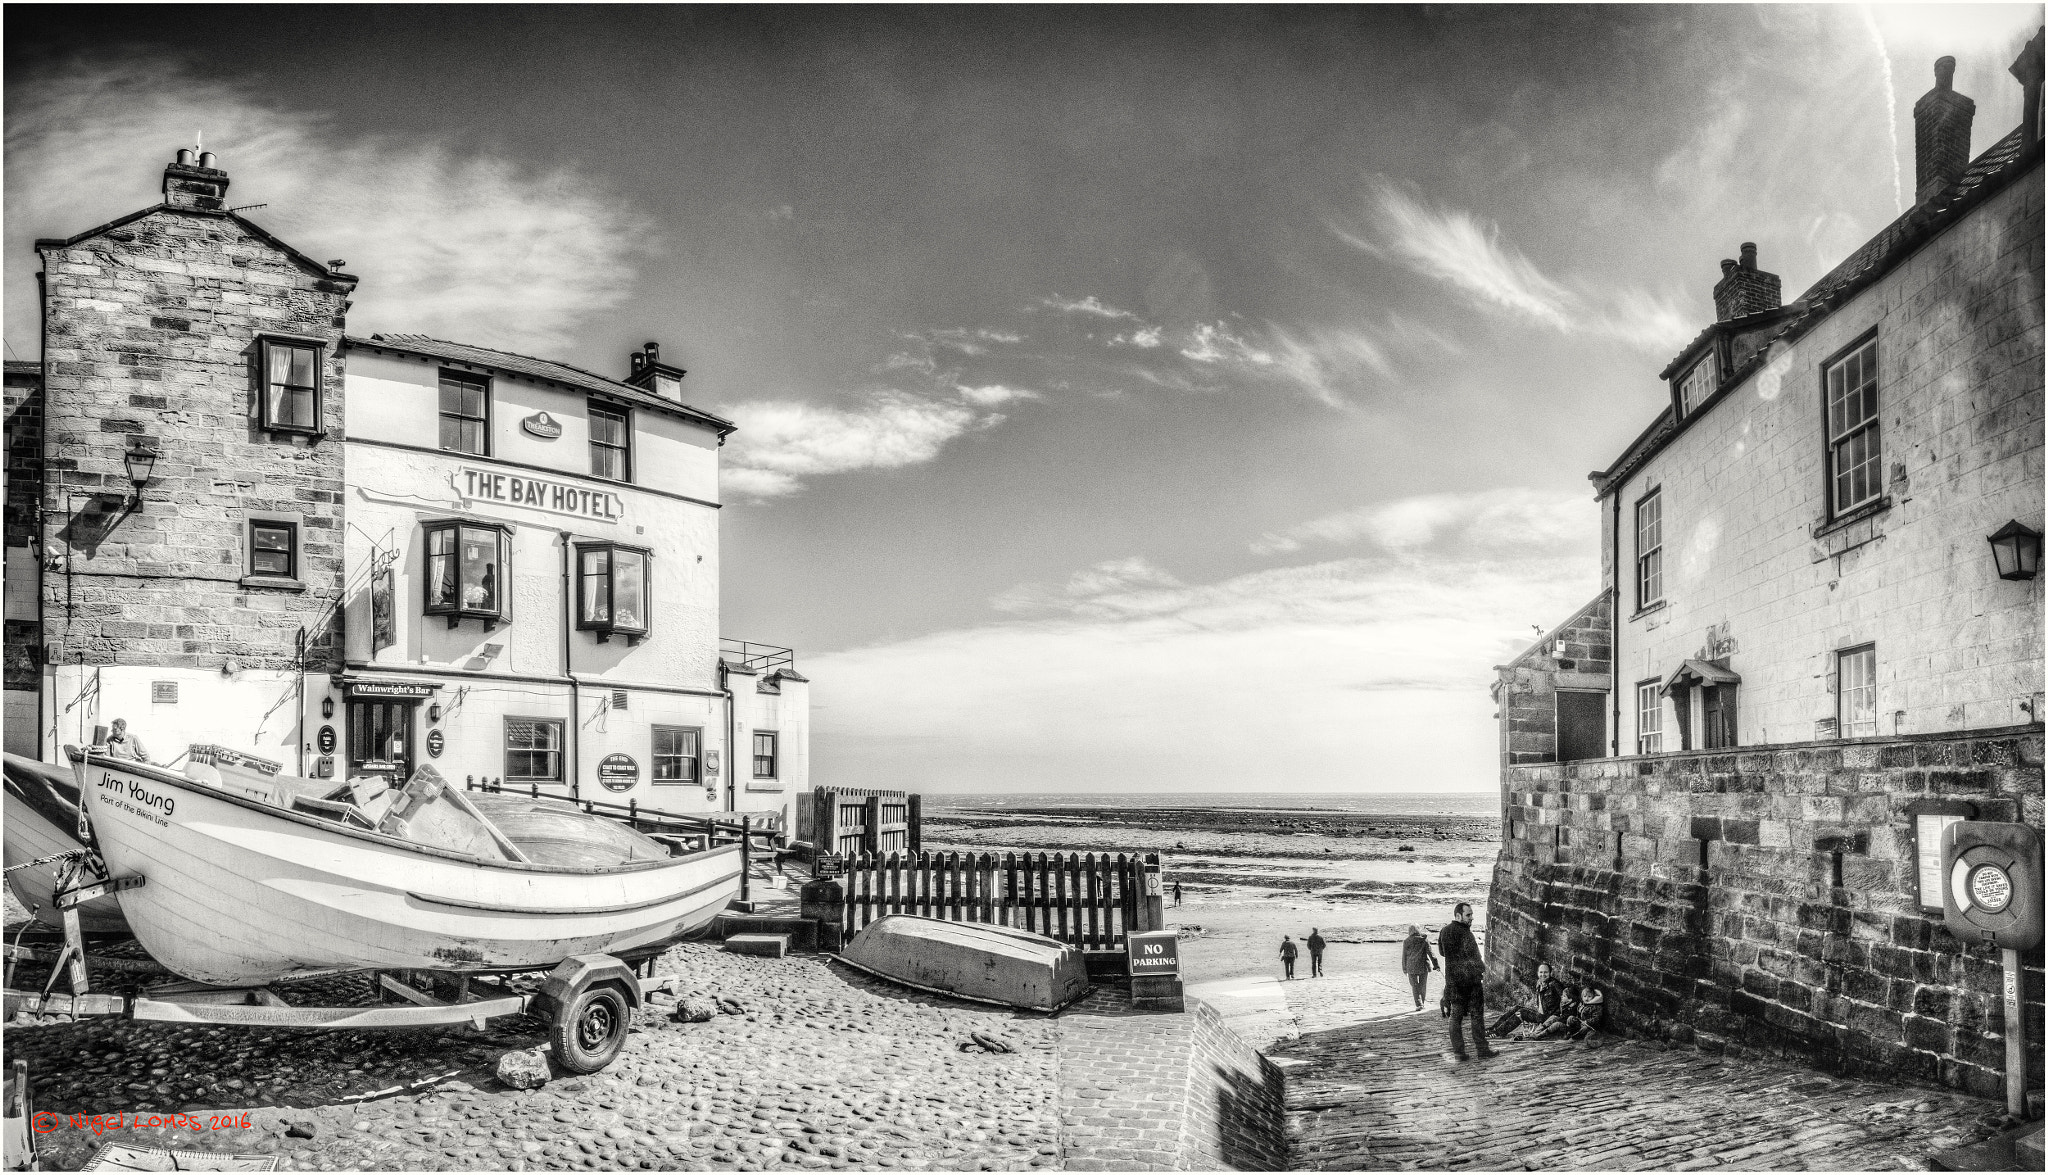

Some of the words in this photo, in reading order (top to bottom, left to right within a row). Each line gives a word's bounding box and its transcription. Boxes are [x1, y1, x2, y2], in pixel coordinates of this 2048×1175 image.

[526, 420, 561, 434] THEAKSTON
[465, 471, 506, 501] THE
[510, 477, 548, 508] BAY
[552, 485, 616, 519] HOTEL
[357, 684, 414, 695] Wainwright's
[415, 686, 431, 695] Bar
[98, 772, 123, 794] Jim
[129, 780, 175, 816] Young
[101, 794, 114, 806] Part
[115, 800, 123, 808] of
[124, 803, 135, 814] the
[136, 808, 154, 822] Bikini
[1143, 944, 1164, 955] NO
[1133, 957, 1176, 967] PARKING
